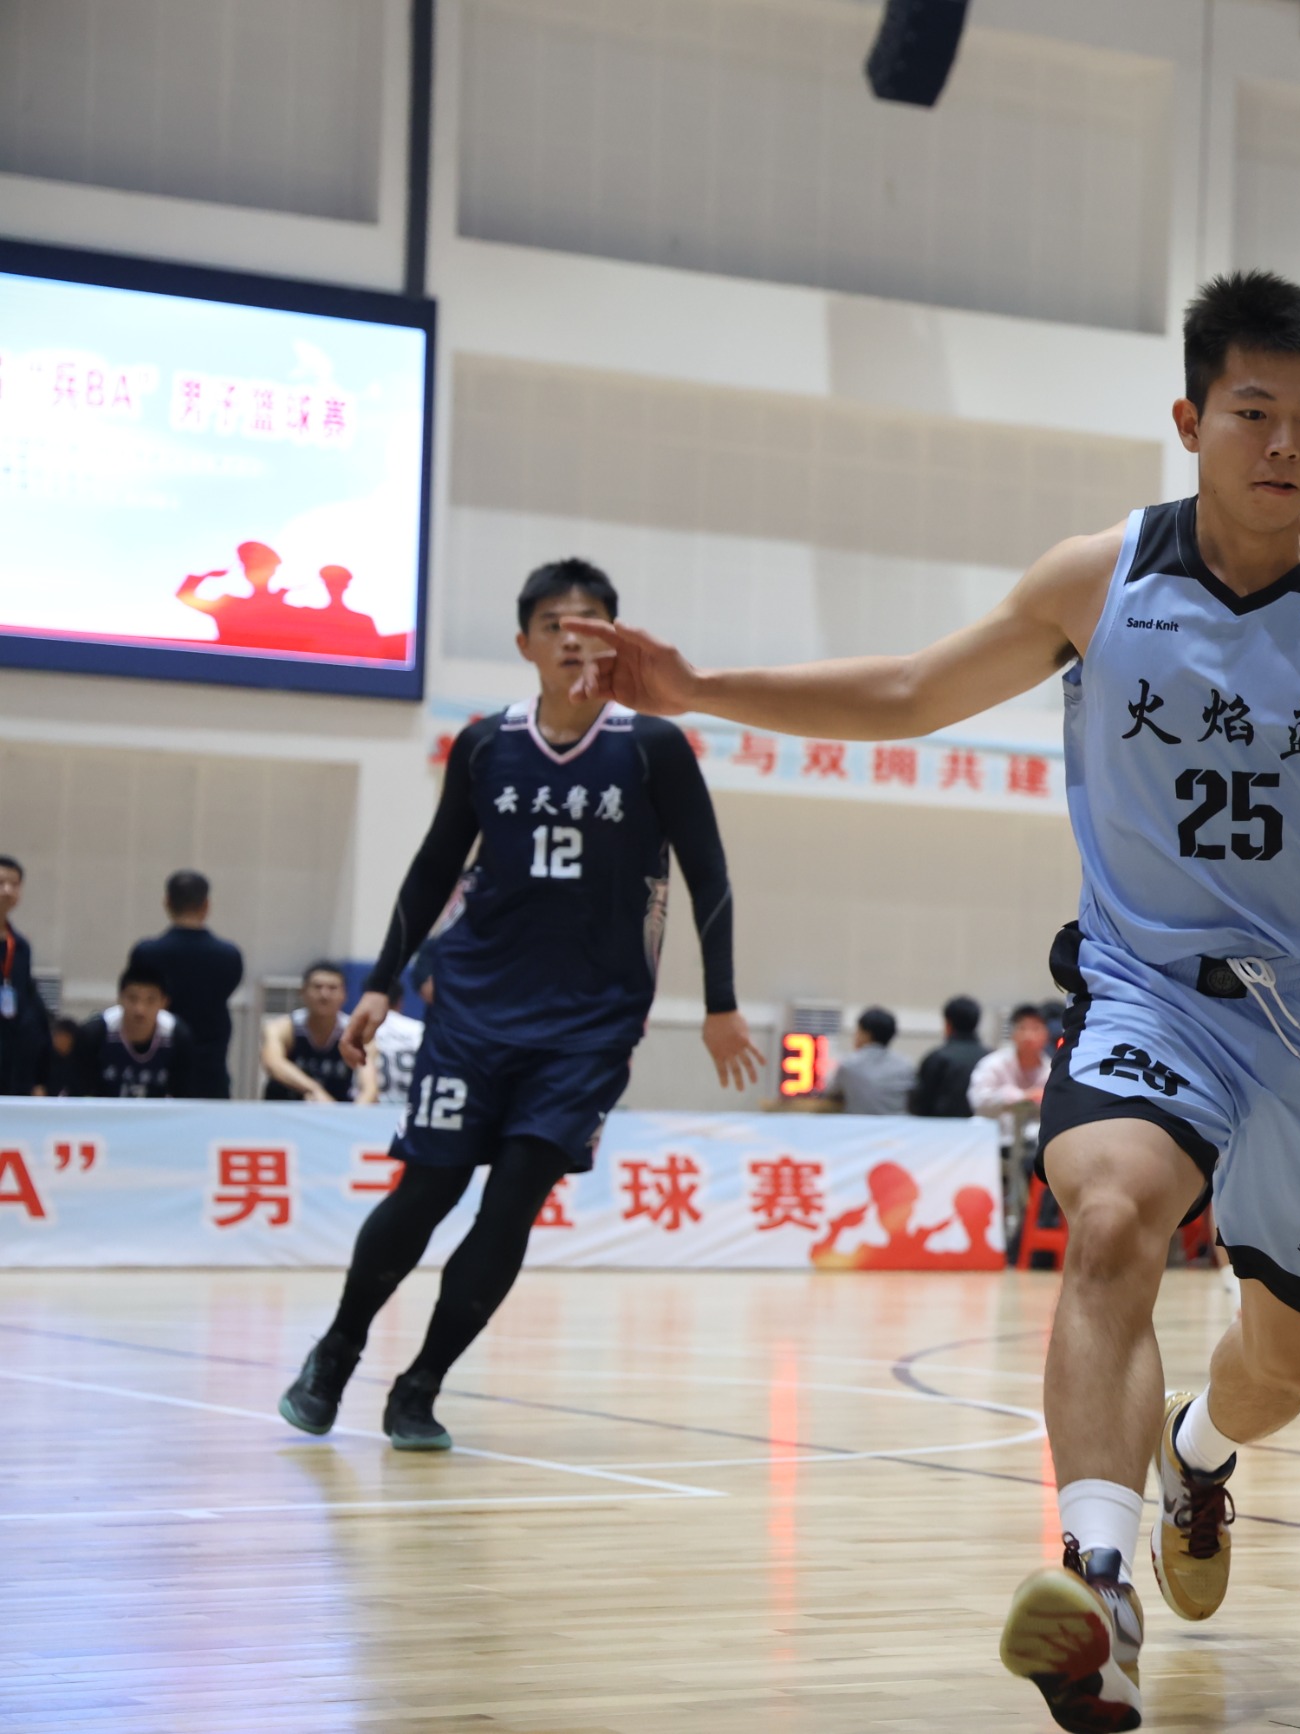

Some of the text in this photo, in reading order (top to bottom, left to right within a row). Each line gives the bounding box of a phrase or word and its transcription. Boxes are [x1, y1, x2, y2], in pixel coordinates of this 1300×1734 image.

[494, 784, 625, 822] 云天警鹰
[1174, 768, 1283, 861] 25
[530, 826, 583, 879] 12
[414, 1075, 468, 1131] 12
[210, 1147, 826, 1230] 男球赛
